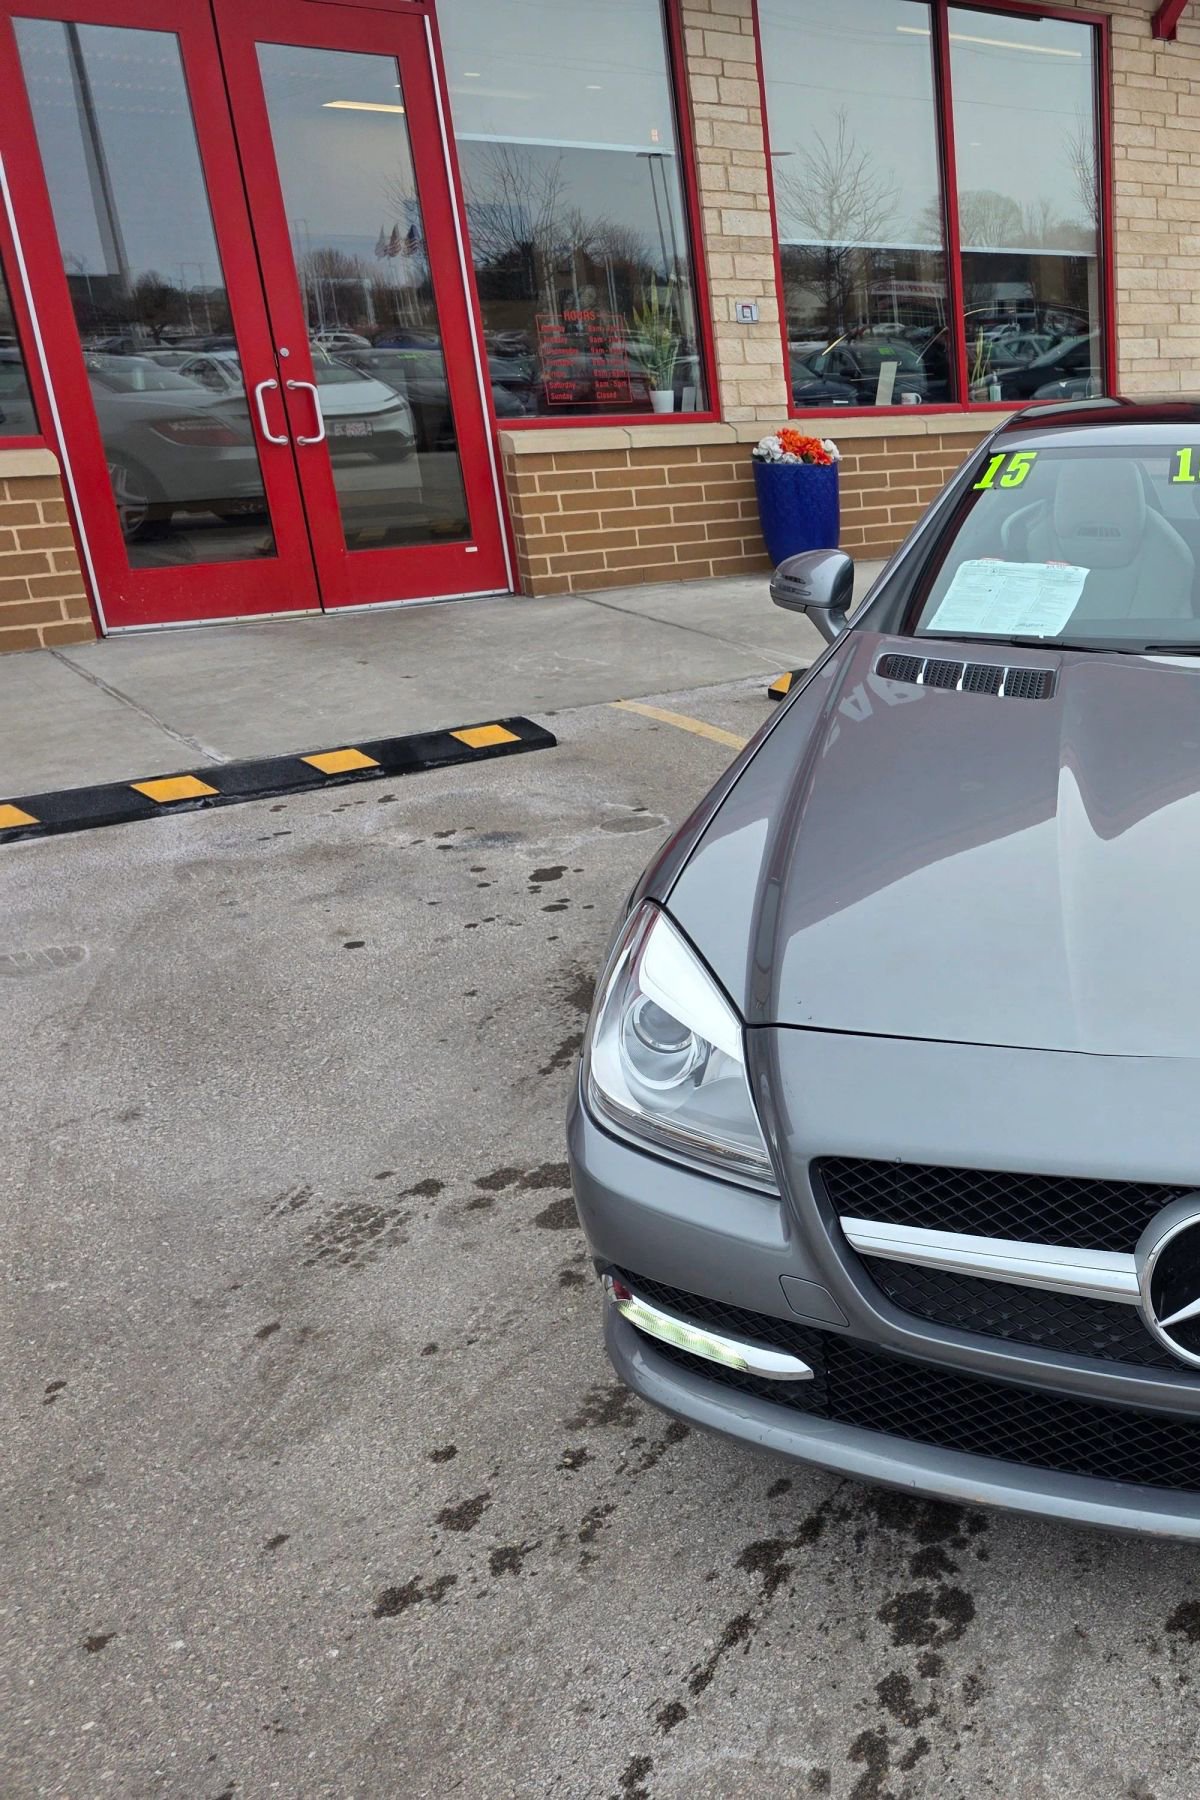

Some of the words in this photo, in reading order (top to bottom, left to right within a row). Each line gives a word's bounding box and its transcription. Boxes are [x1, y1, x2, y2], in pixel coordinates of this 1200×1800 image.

[563, 310, 597, 322] HOURS
[550, 392, 573, 401] Sunday
[596, 391, 617, 399] Closed
[973, 451, 1038, 490] 15
